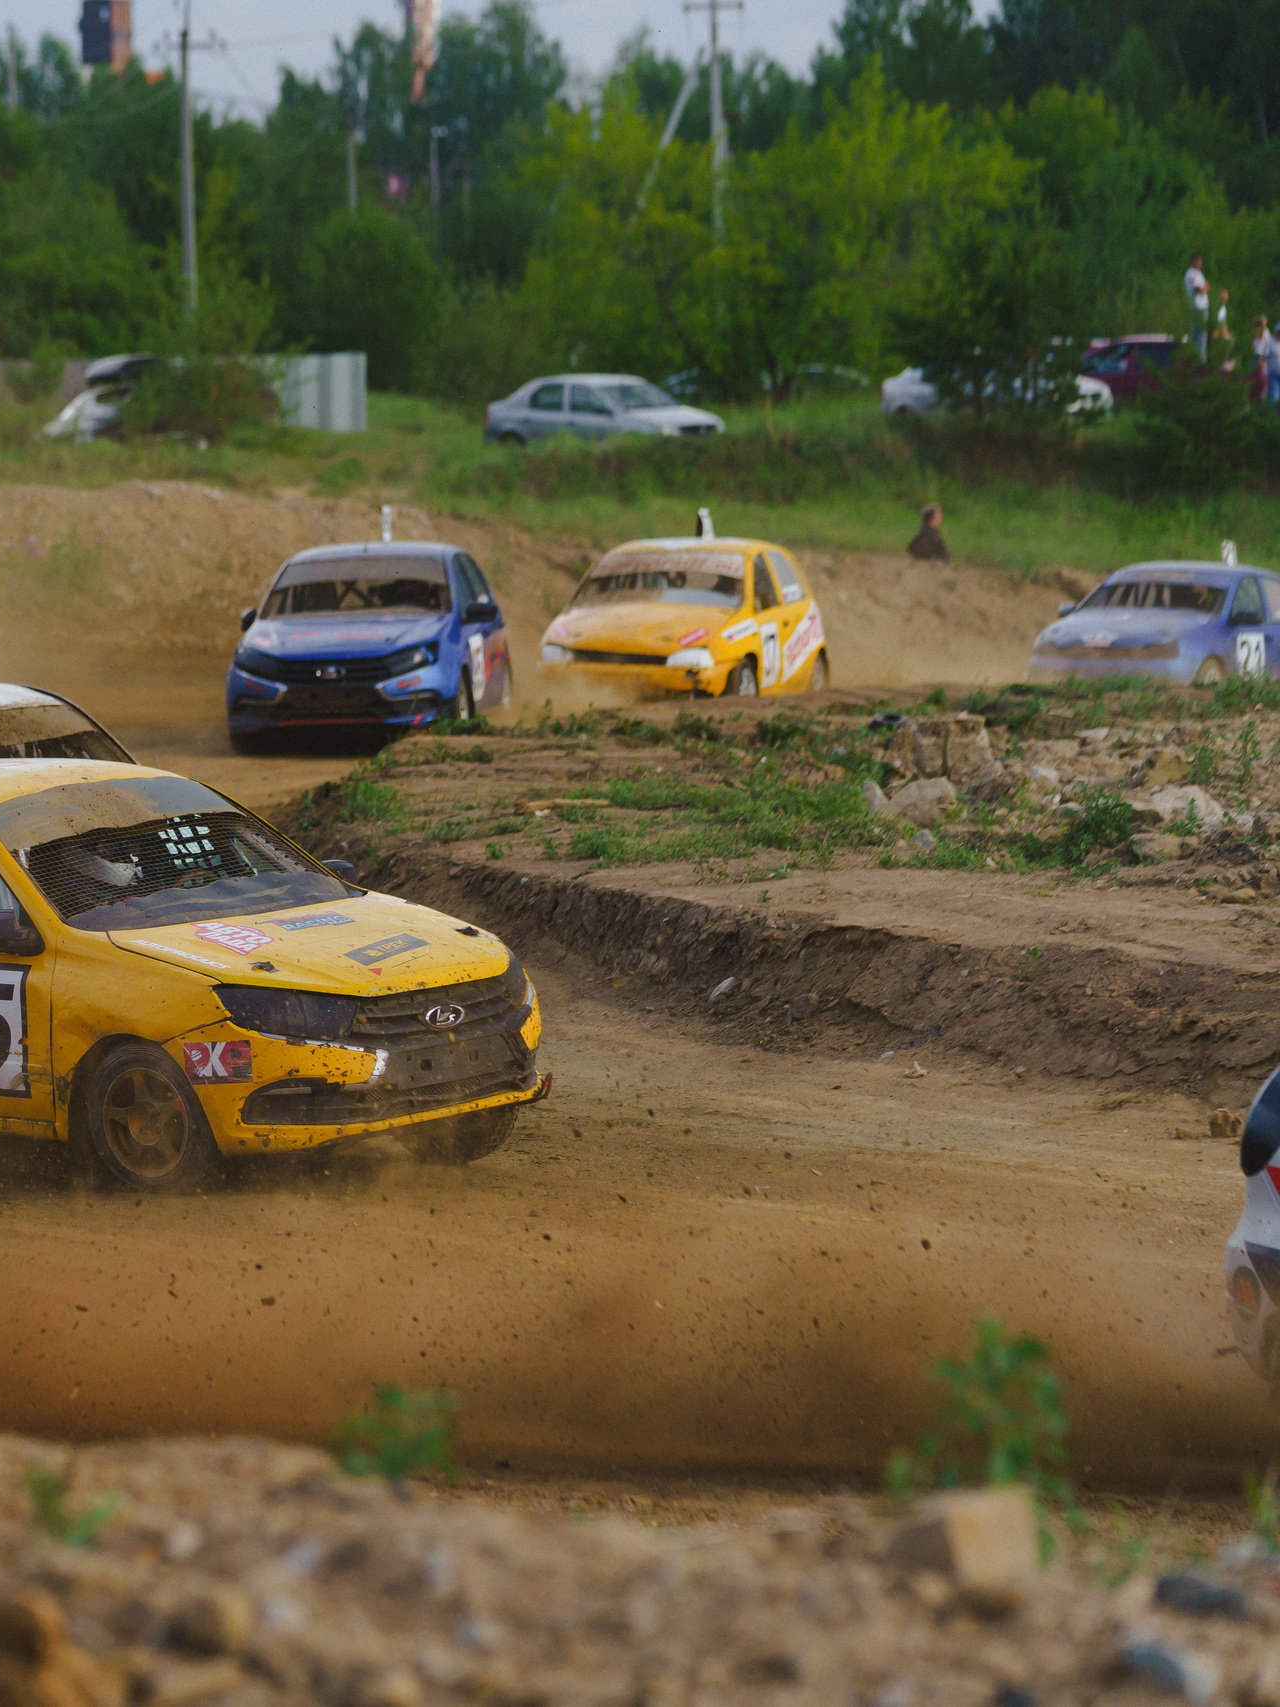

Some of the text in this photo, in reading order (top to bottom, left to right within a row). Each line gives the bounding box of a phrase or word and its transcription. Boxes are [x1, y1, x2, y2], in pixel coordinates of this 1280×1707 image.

[195, 921, 272, 944] АВТО
[198, 931, 258, 952] ЛАДА
[131, 939, 231, 970] AUTOPRODUCT
